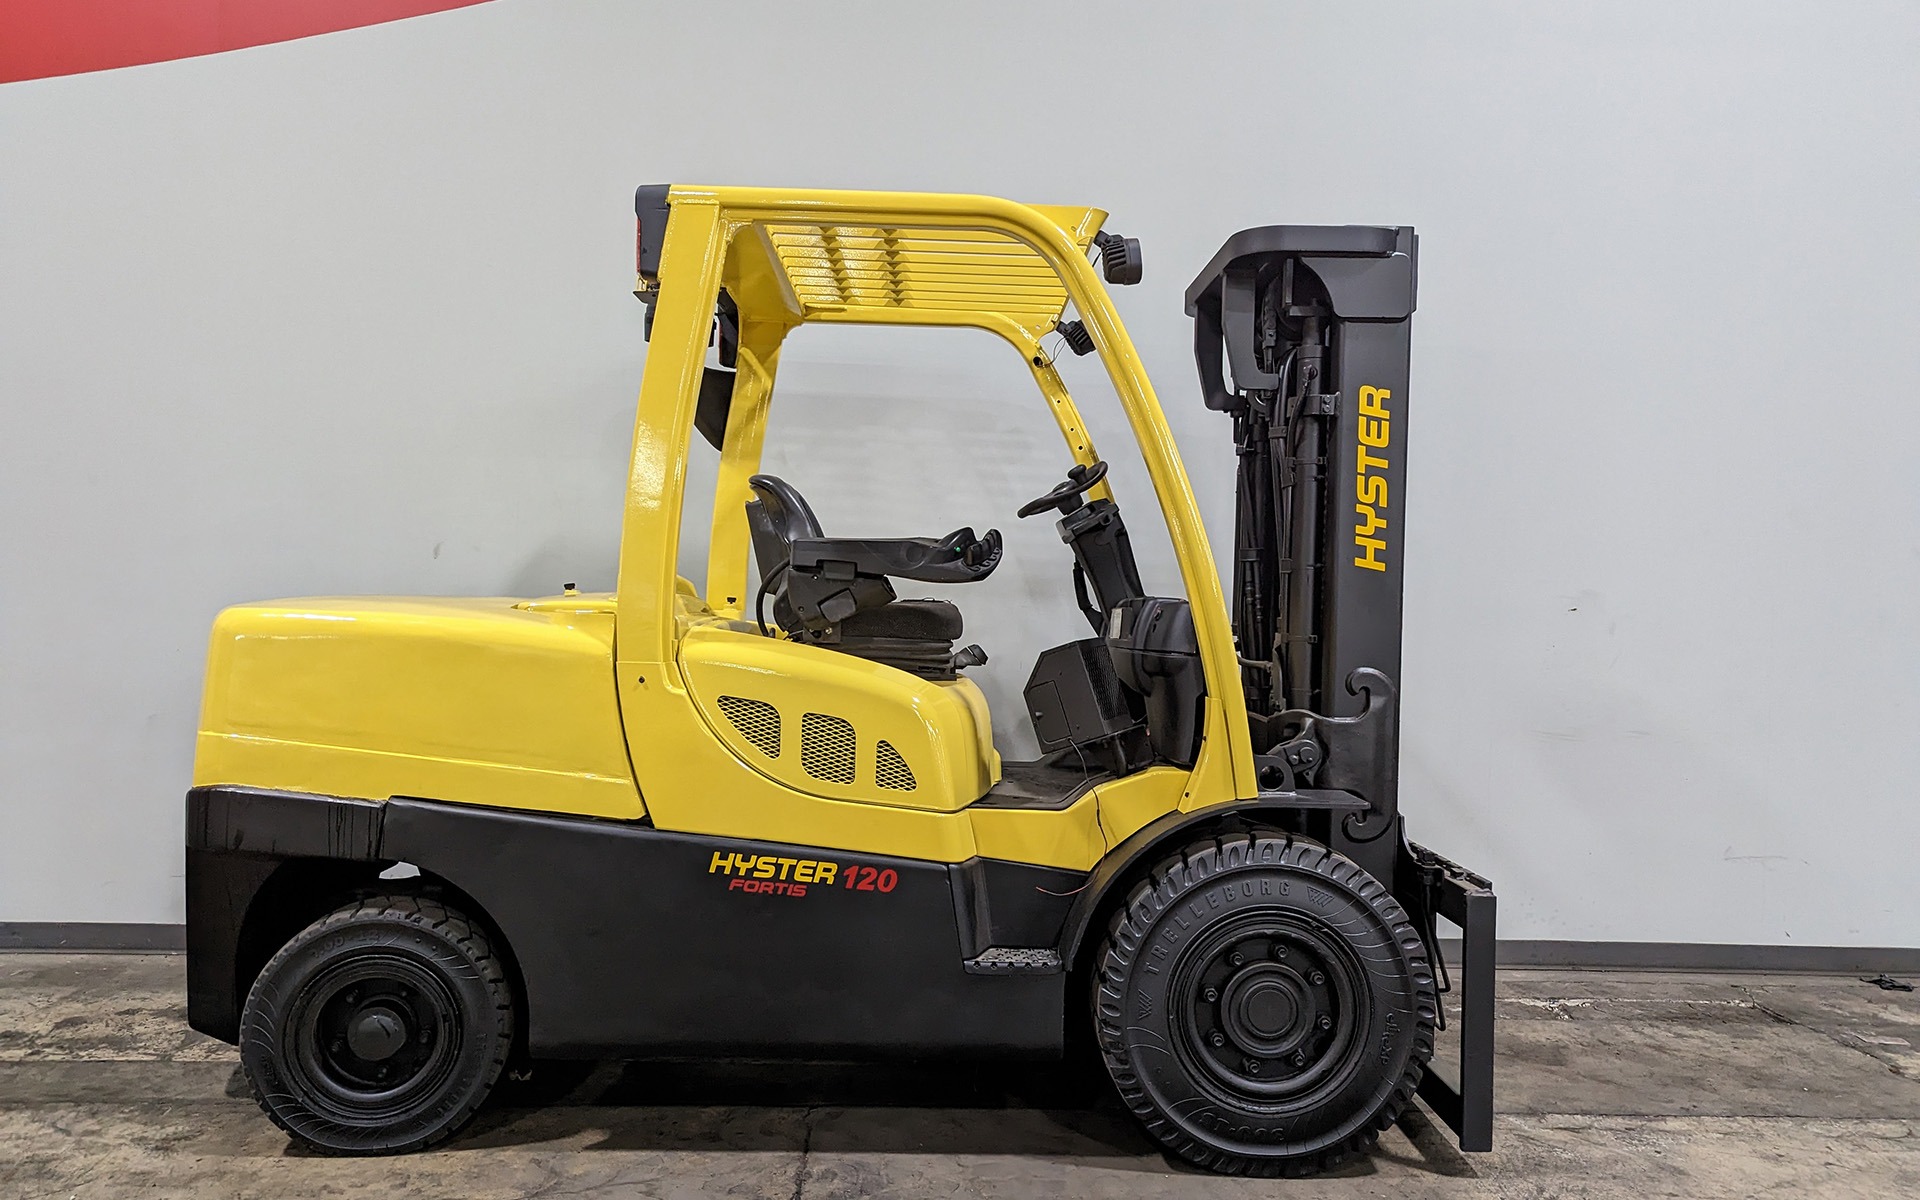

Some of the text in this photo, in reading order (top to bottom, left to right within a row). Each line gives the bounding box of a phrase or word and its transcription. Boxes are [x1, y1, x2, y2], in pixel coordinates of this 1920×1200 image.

[1354, 384, 1391, 572] HYSTER
[708, 851, 898, 893] HYSTER 120
[728, 878, 808, 897] FORTIS
[1144, 878, 1291, 976] TRELLEBORG
